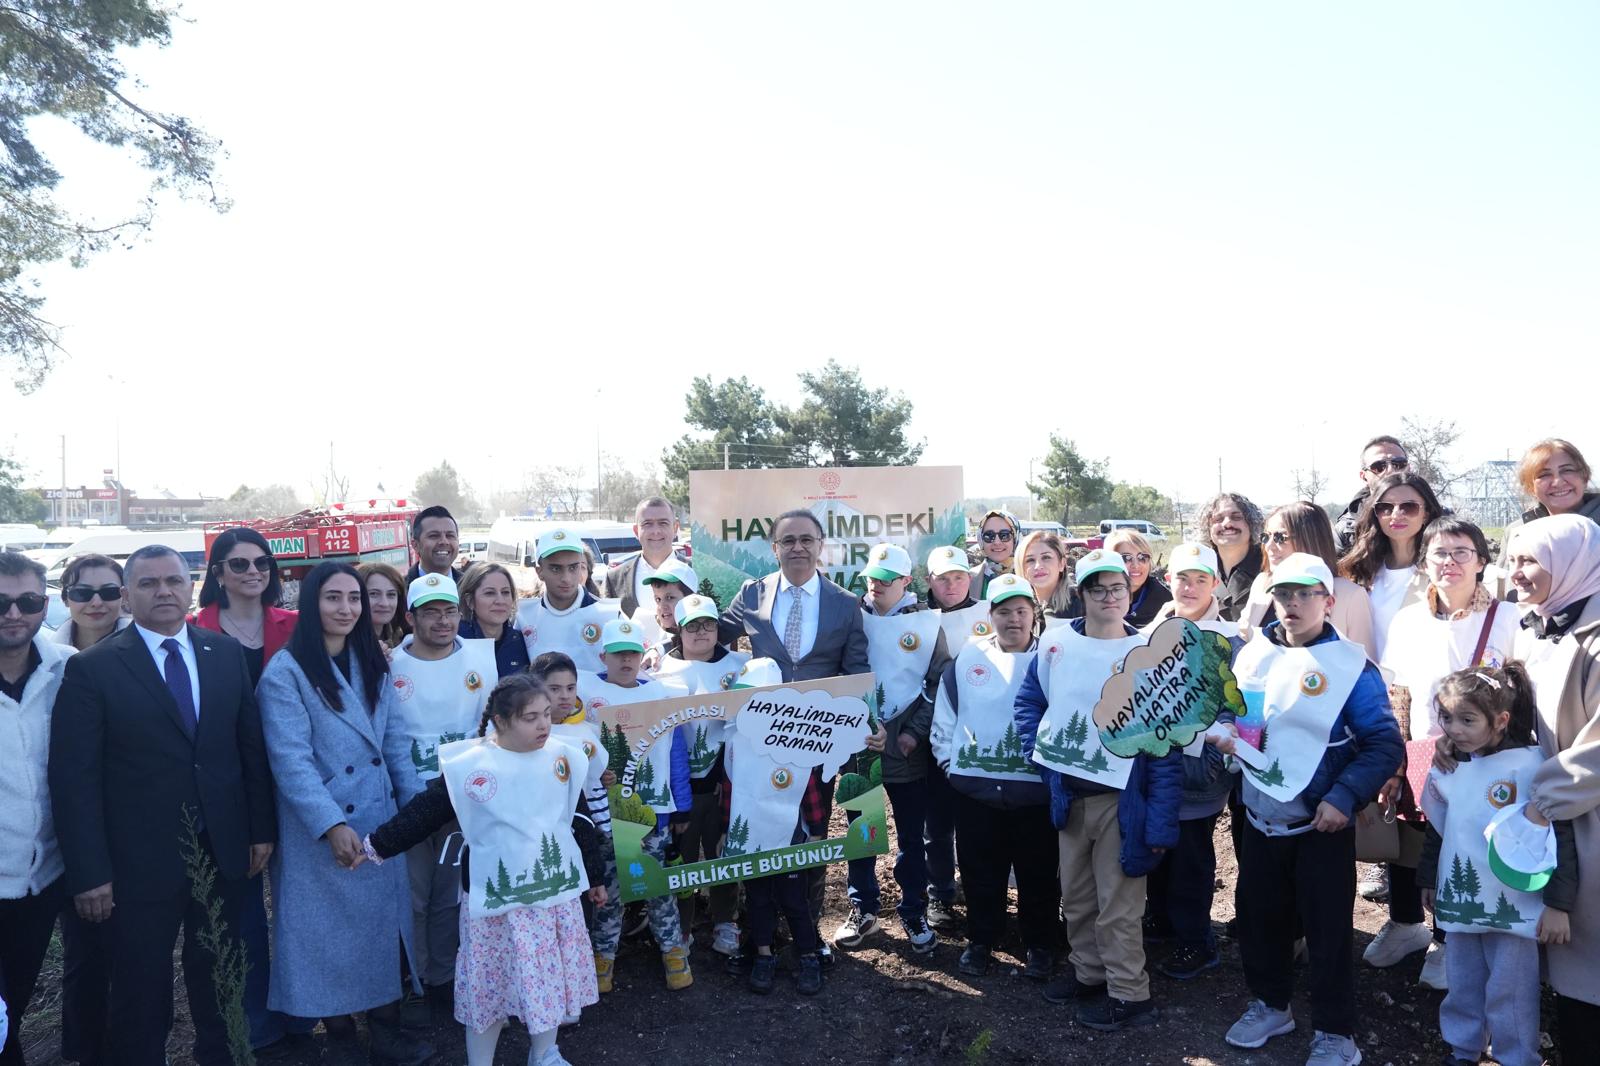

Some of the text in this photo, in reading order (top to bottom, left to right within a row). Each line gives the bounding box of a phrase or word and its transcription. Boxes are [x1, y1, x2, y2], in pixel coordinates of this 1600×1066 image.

[325, 529, 349, 540] ALO
[721, 507, 935, 542] HAİMDEKİ
[269, 537, 305, 554] MAN
[325, 540, 350, 550] 112
[1105, 625, 1198, 739] HAYALİMDEKİ
[1139, 666, 1193, 728] HATIRA
[747, 699, 865, 729] HAYALİMDEKİ
[1154, 674, 1212, 741] ORMANI
[764, 734, 834, 754] ORMANI
[769, 718, 833, 739] HATIRA
[621, 704, 726, 799] ORMAN HATIRASI
[668, 861, 754, 890] BİRLİKTE
[758, 844, 845, 873] BÜTÜNÜZ
